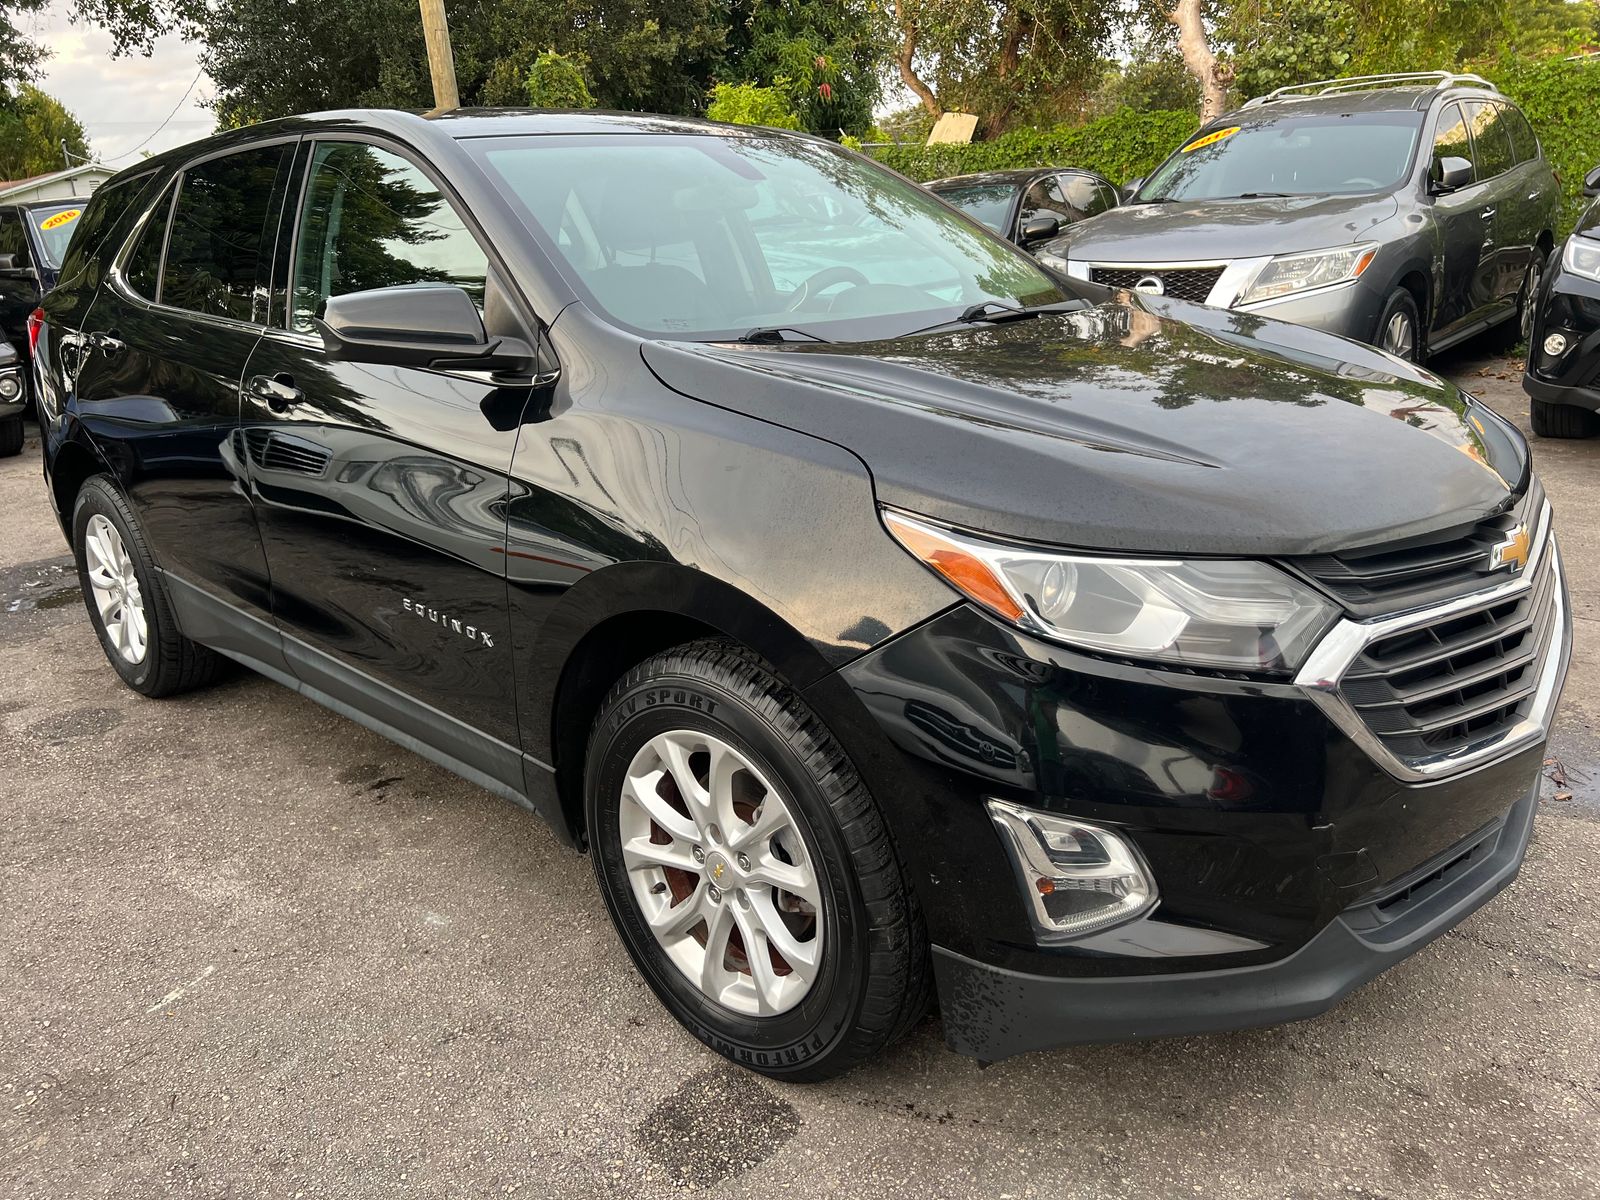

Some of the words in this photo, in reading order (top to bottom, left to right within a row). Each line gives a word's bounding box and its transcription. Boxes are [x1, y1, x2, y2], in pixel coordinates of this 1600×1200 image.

[46, 211, 76, 228] 2016
[403, 598, 494, 648] EQUINOX
[645, 690, 720, 714] SPORT
